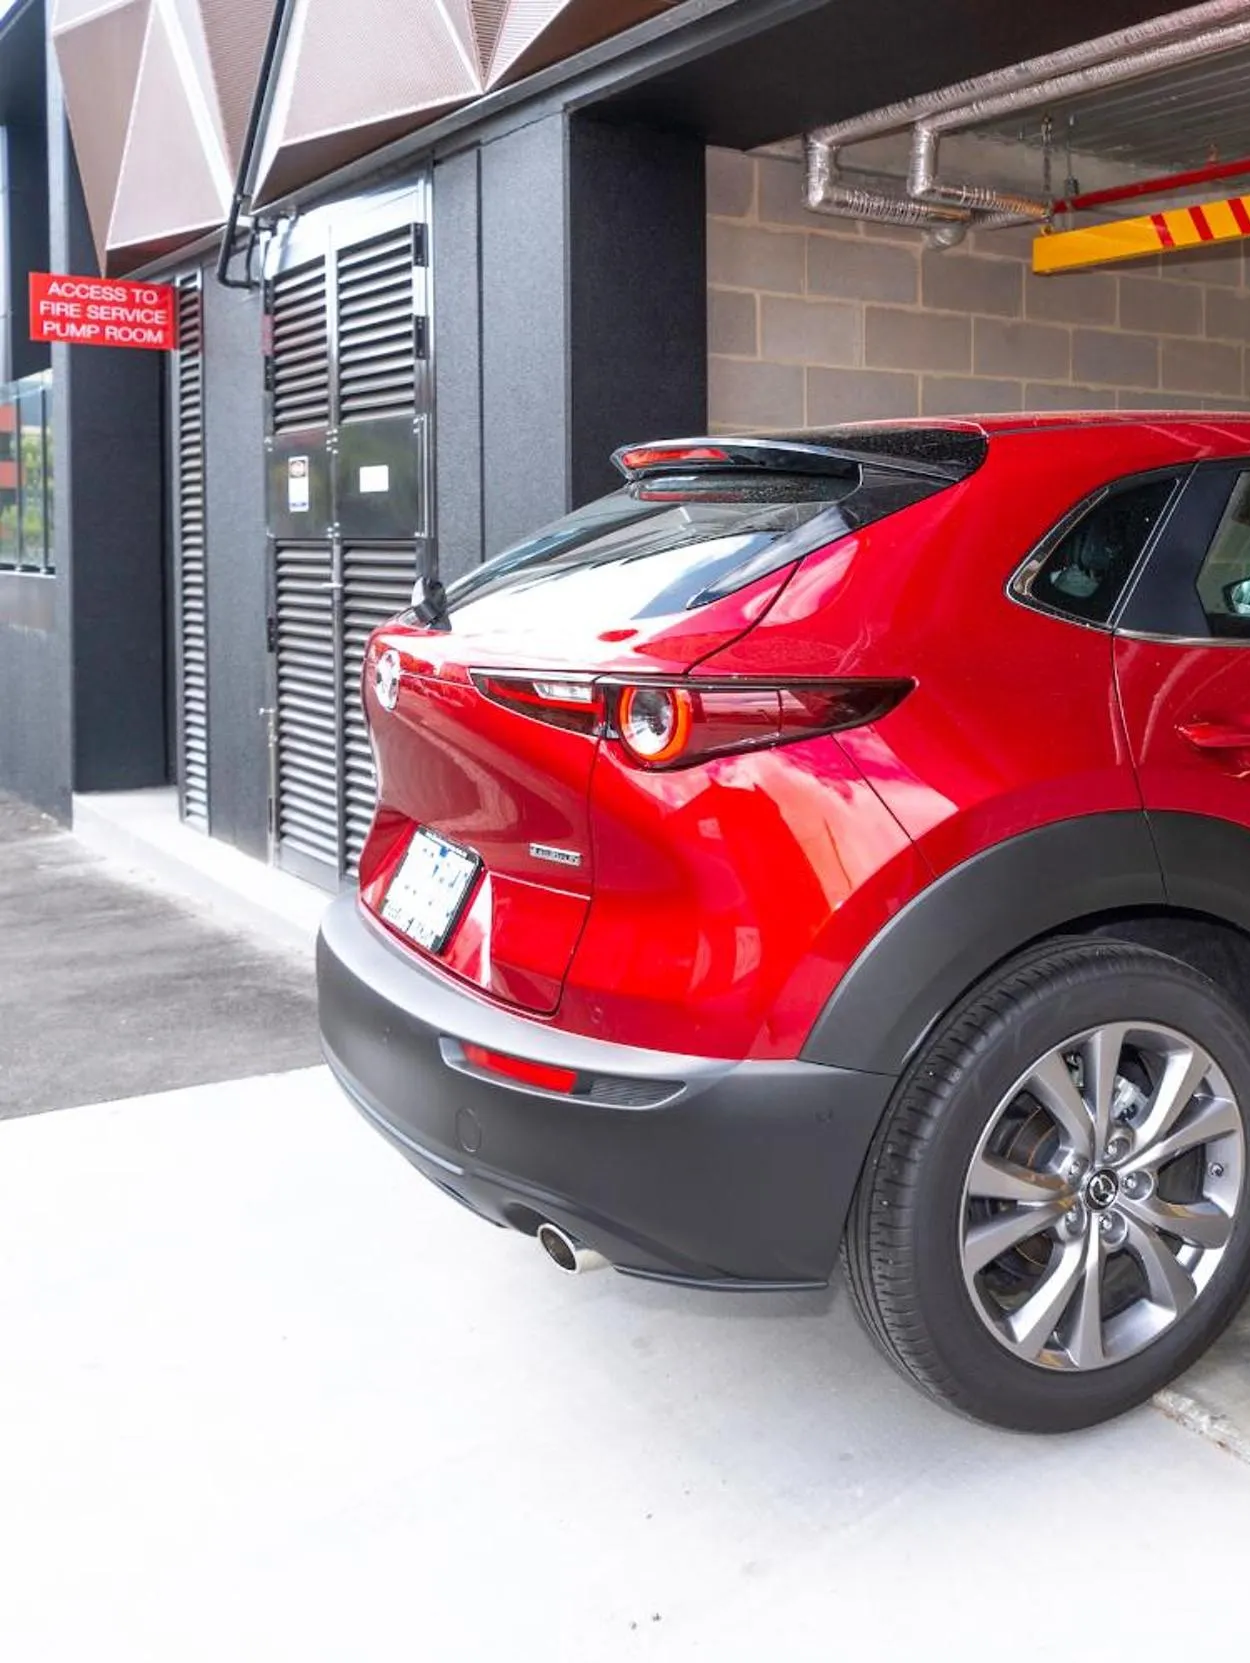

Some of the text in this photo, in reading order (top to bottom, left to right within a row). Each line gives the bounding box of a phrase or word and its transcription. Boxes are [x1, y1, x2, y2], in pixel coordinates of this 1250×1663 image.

[48, 281, 158, 304] ACCESS TO
[39, 301, 167, 325] FIRE SERVICE
[42, 320, 163, 344] PUMP ROOM
